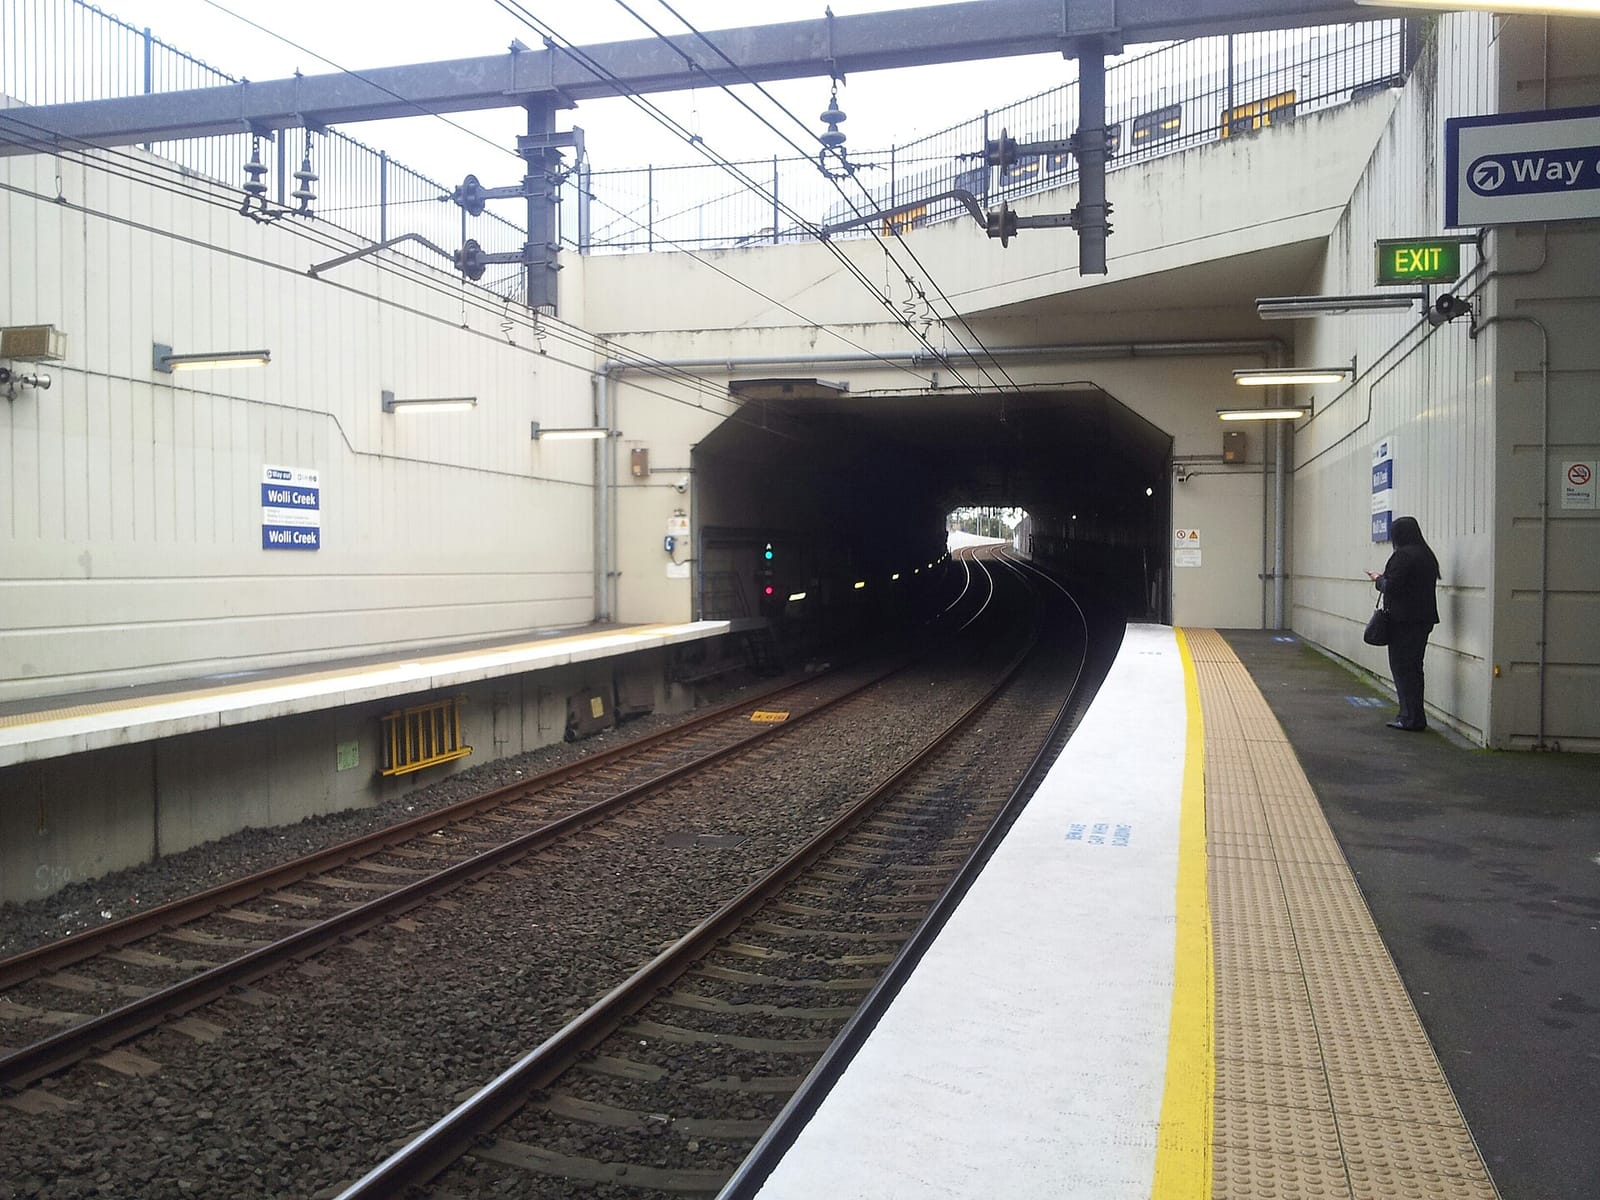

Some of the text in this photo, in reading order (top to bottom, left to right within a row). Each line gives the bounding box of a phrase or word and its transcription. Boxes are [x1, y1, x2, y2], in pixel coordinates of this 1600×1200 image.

[1512, 157, 1584, 185] Way
[1394, 247, 1442, 273] EXIT
[268, 489, 316, 505] Wolli Creek
[269, 530, 317, 545] Wolli Creek
